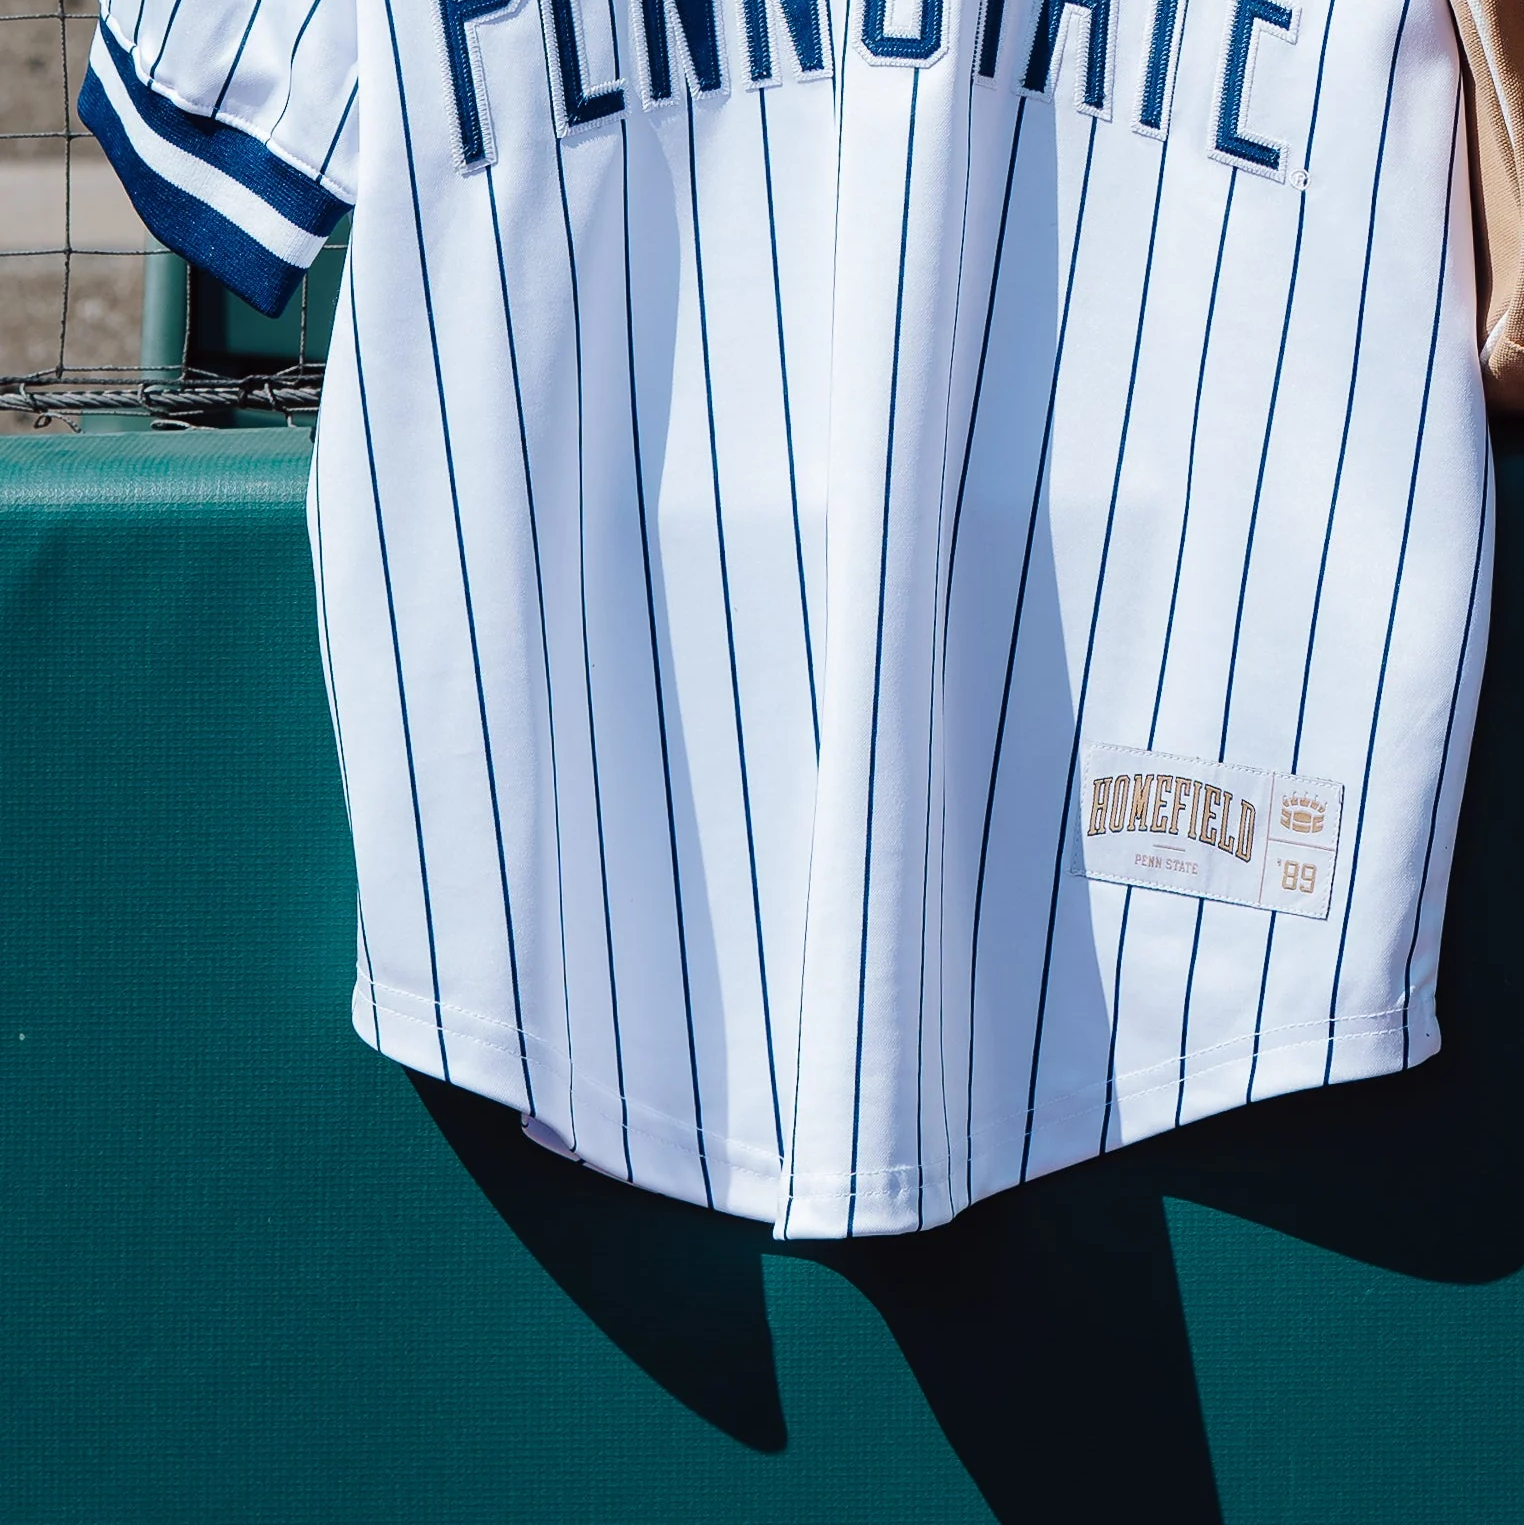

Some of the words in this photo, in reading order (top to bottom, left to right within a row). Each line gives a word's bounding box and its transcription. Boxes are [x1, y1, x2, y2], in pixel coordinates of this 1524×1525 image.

[1087, 774, 1256, 863] HOMEFIELD
[1134, 853, 1163, 870] PENN
[1165, 854, 1199, 876] STATE
[1276, 857, 1318, 894] '89
